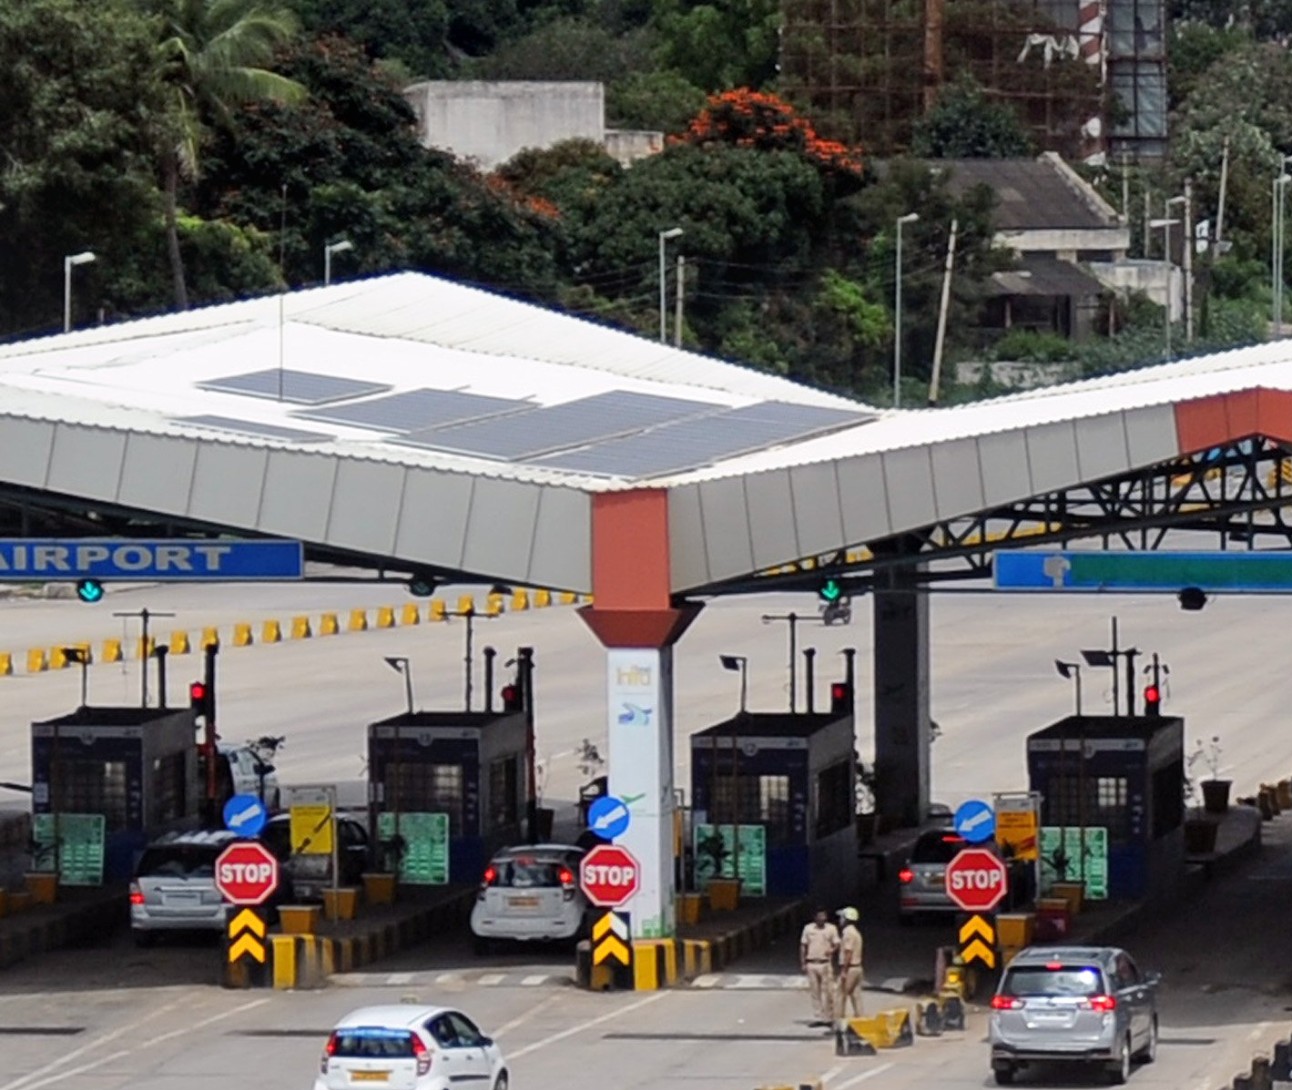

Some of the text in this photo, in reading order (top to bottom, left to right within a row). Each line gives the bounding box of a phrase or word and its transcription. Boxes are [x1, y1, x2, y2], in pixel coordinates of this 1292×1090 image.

[220, 863, 272, 884] STOP
[584, 865, 635, 887] STOP
[951, 869, 1002, 890] STOP
